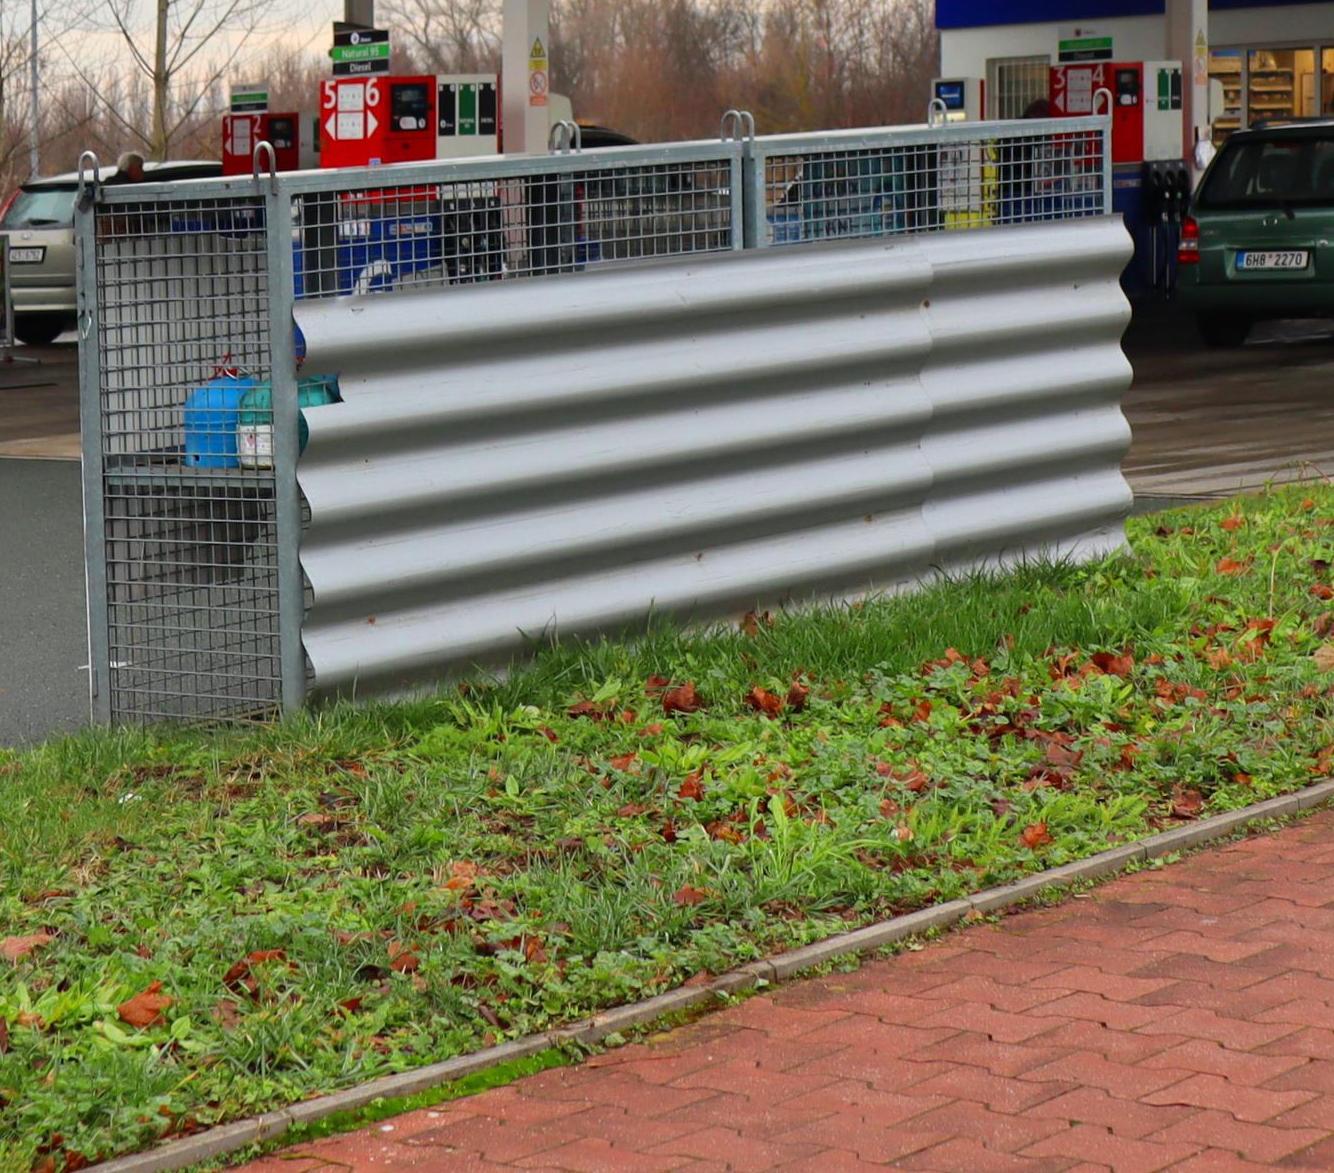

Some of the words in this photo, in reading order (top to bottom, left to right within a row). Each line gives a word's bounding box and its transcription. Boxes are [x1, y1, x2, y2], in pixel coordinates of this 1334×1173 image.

[341, 46, 369, 59] Natural
[349, 61, 372, 73] Diesel
[1053, 65, 1066, 89] 3
[1092, 63, 1106, 87] 4
[323, 80, 337, 109] 5
[365, 77, 380, 107] 6
[253, 115, 262, 133] 2
[1274, 252, 1303, 267] 2270
